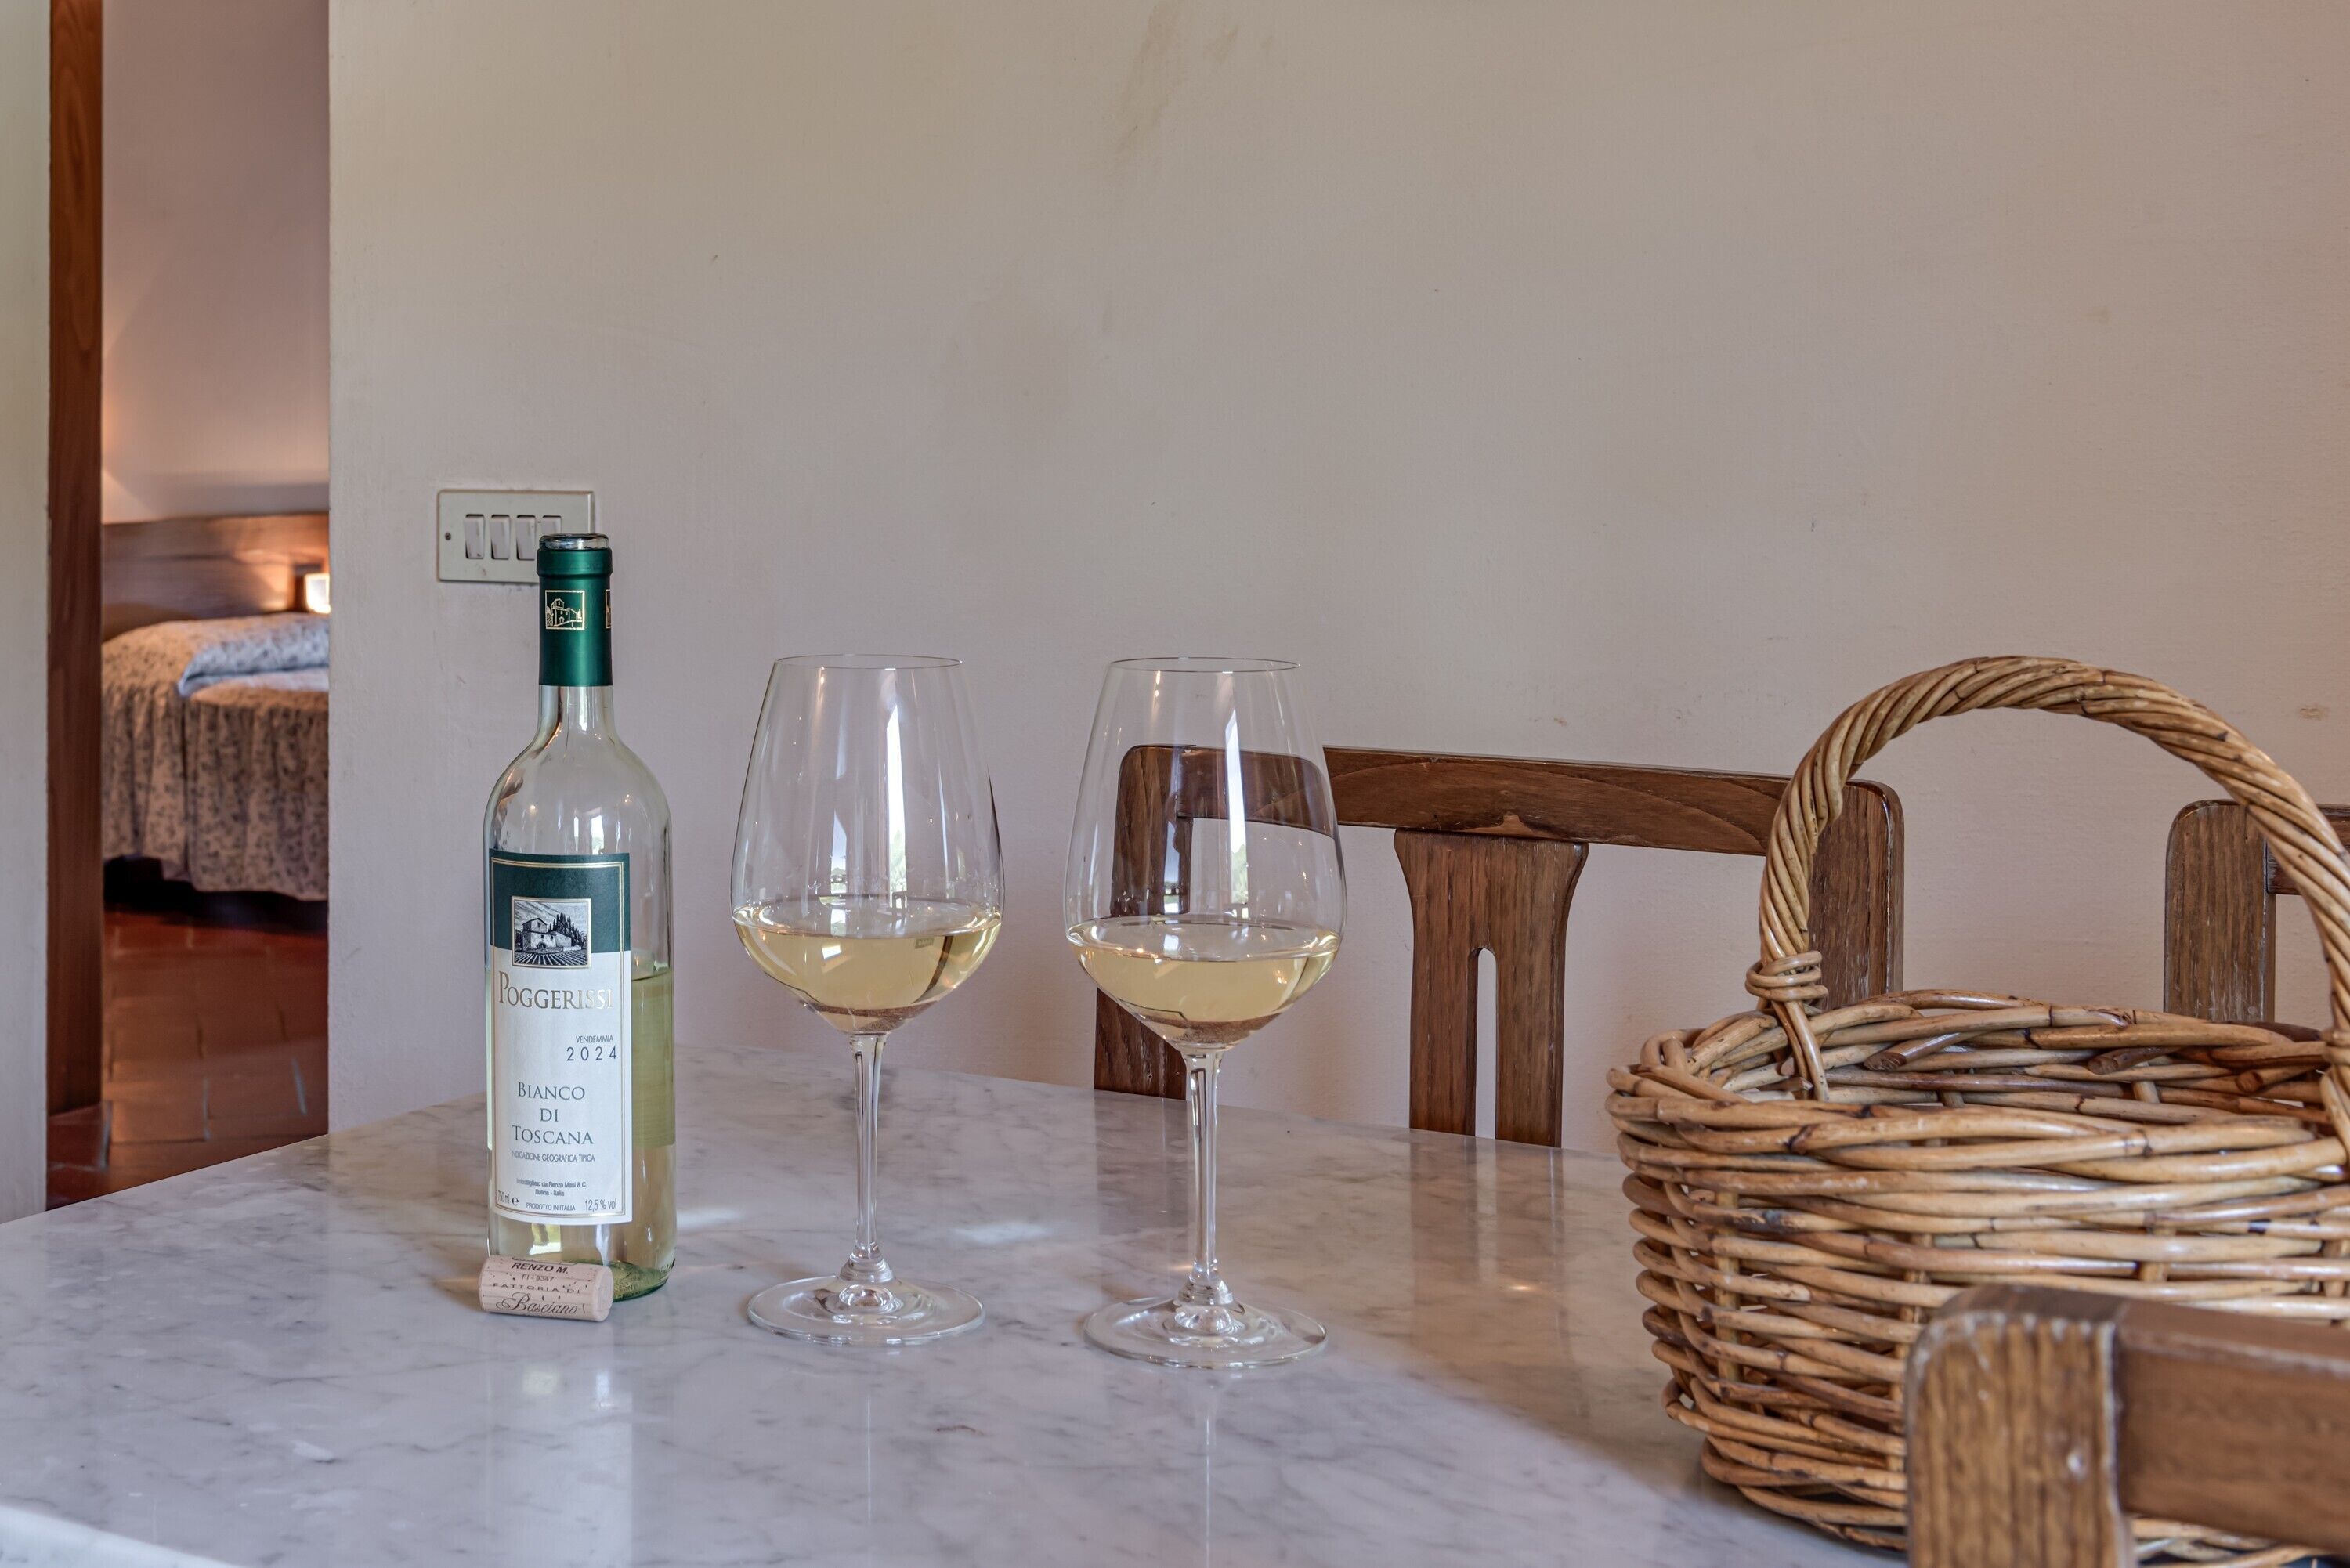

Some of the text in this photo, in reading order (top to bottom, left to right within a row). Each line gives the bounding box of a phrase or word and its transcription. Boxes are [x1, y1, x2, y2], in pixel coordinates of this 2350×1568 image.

[498, 971, 615, 1010] POGGERISSI
[576, 1035, 614, 1044] VENDEMMIA
[566, 1046, 617, 1061] 2024
[518, 1082, 585, 1100] BIANCO
[540, 1108, 559, 1122] DI
[512, 1125, 594, 1145] TOSCANA
[542, 1154, 577, 1162] GEOGRAFICA
[585, 1198, 617, 1212] 12,5 % vol
[512, 1262, 569, 1274] RENZO M.
[493, 1283, 559, 1292] FATTORIA
[496, 1292, 578, 1314] Basciano
